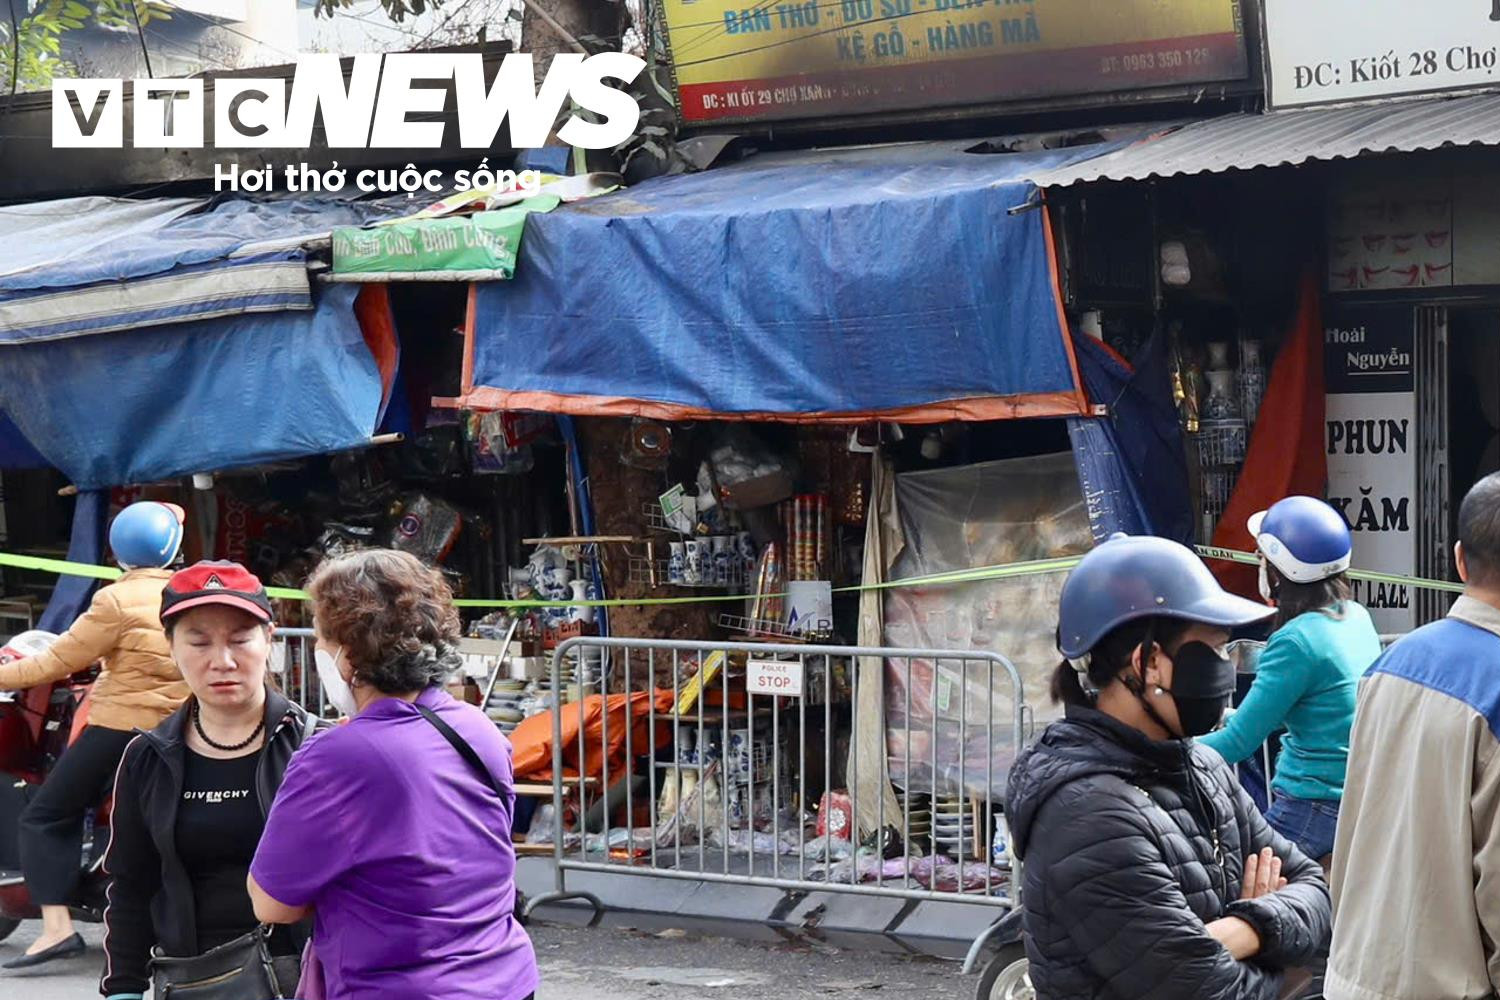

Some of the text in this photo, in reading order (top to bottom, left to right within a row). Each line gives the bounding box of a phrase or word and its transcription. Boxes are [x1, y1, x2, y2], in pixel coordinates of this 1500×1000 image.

[927, 20, 993, 51] HÀNG
[1294, 62, 1341, 89] ĐC:
[1350, 50, 1400, 84] Kiốt
[1409, 50, 1438, 76] 28
[1445, 46, 1497, 75] Chợ
[726, 91, 740, 107] KI
[757, 90, 772, 104] 29
[1346, 347, 1410, 370] Nguyễn
[1327, 419, 1410, 455] PHUN
[758, 675, 791, 688] STOP
[184, 789, 249, 800] GIVENCHY
